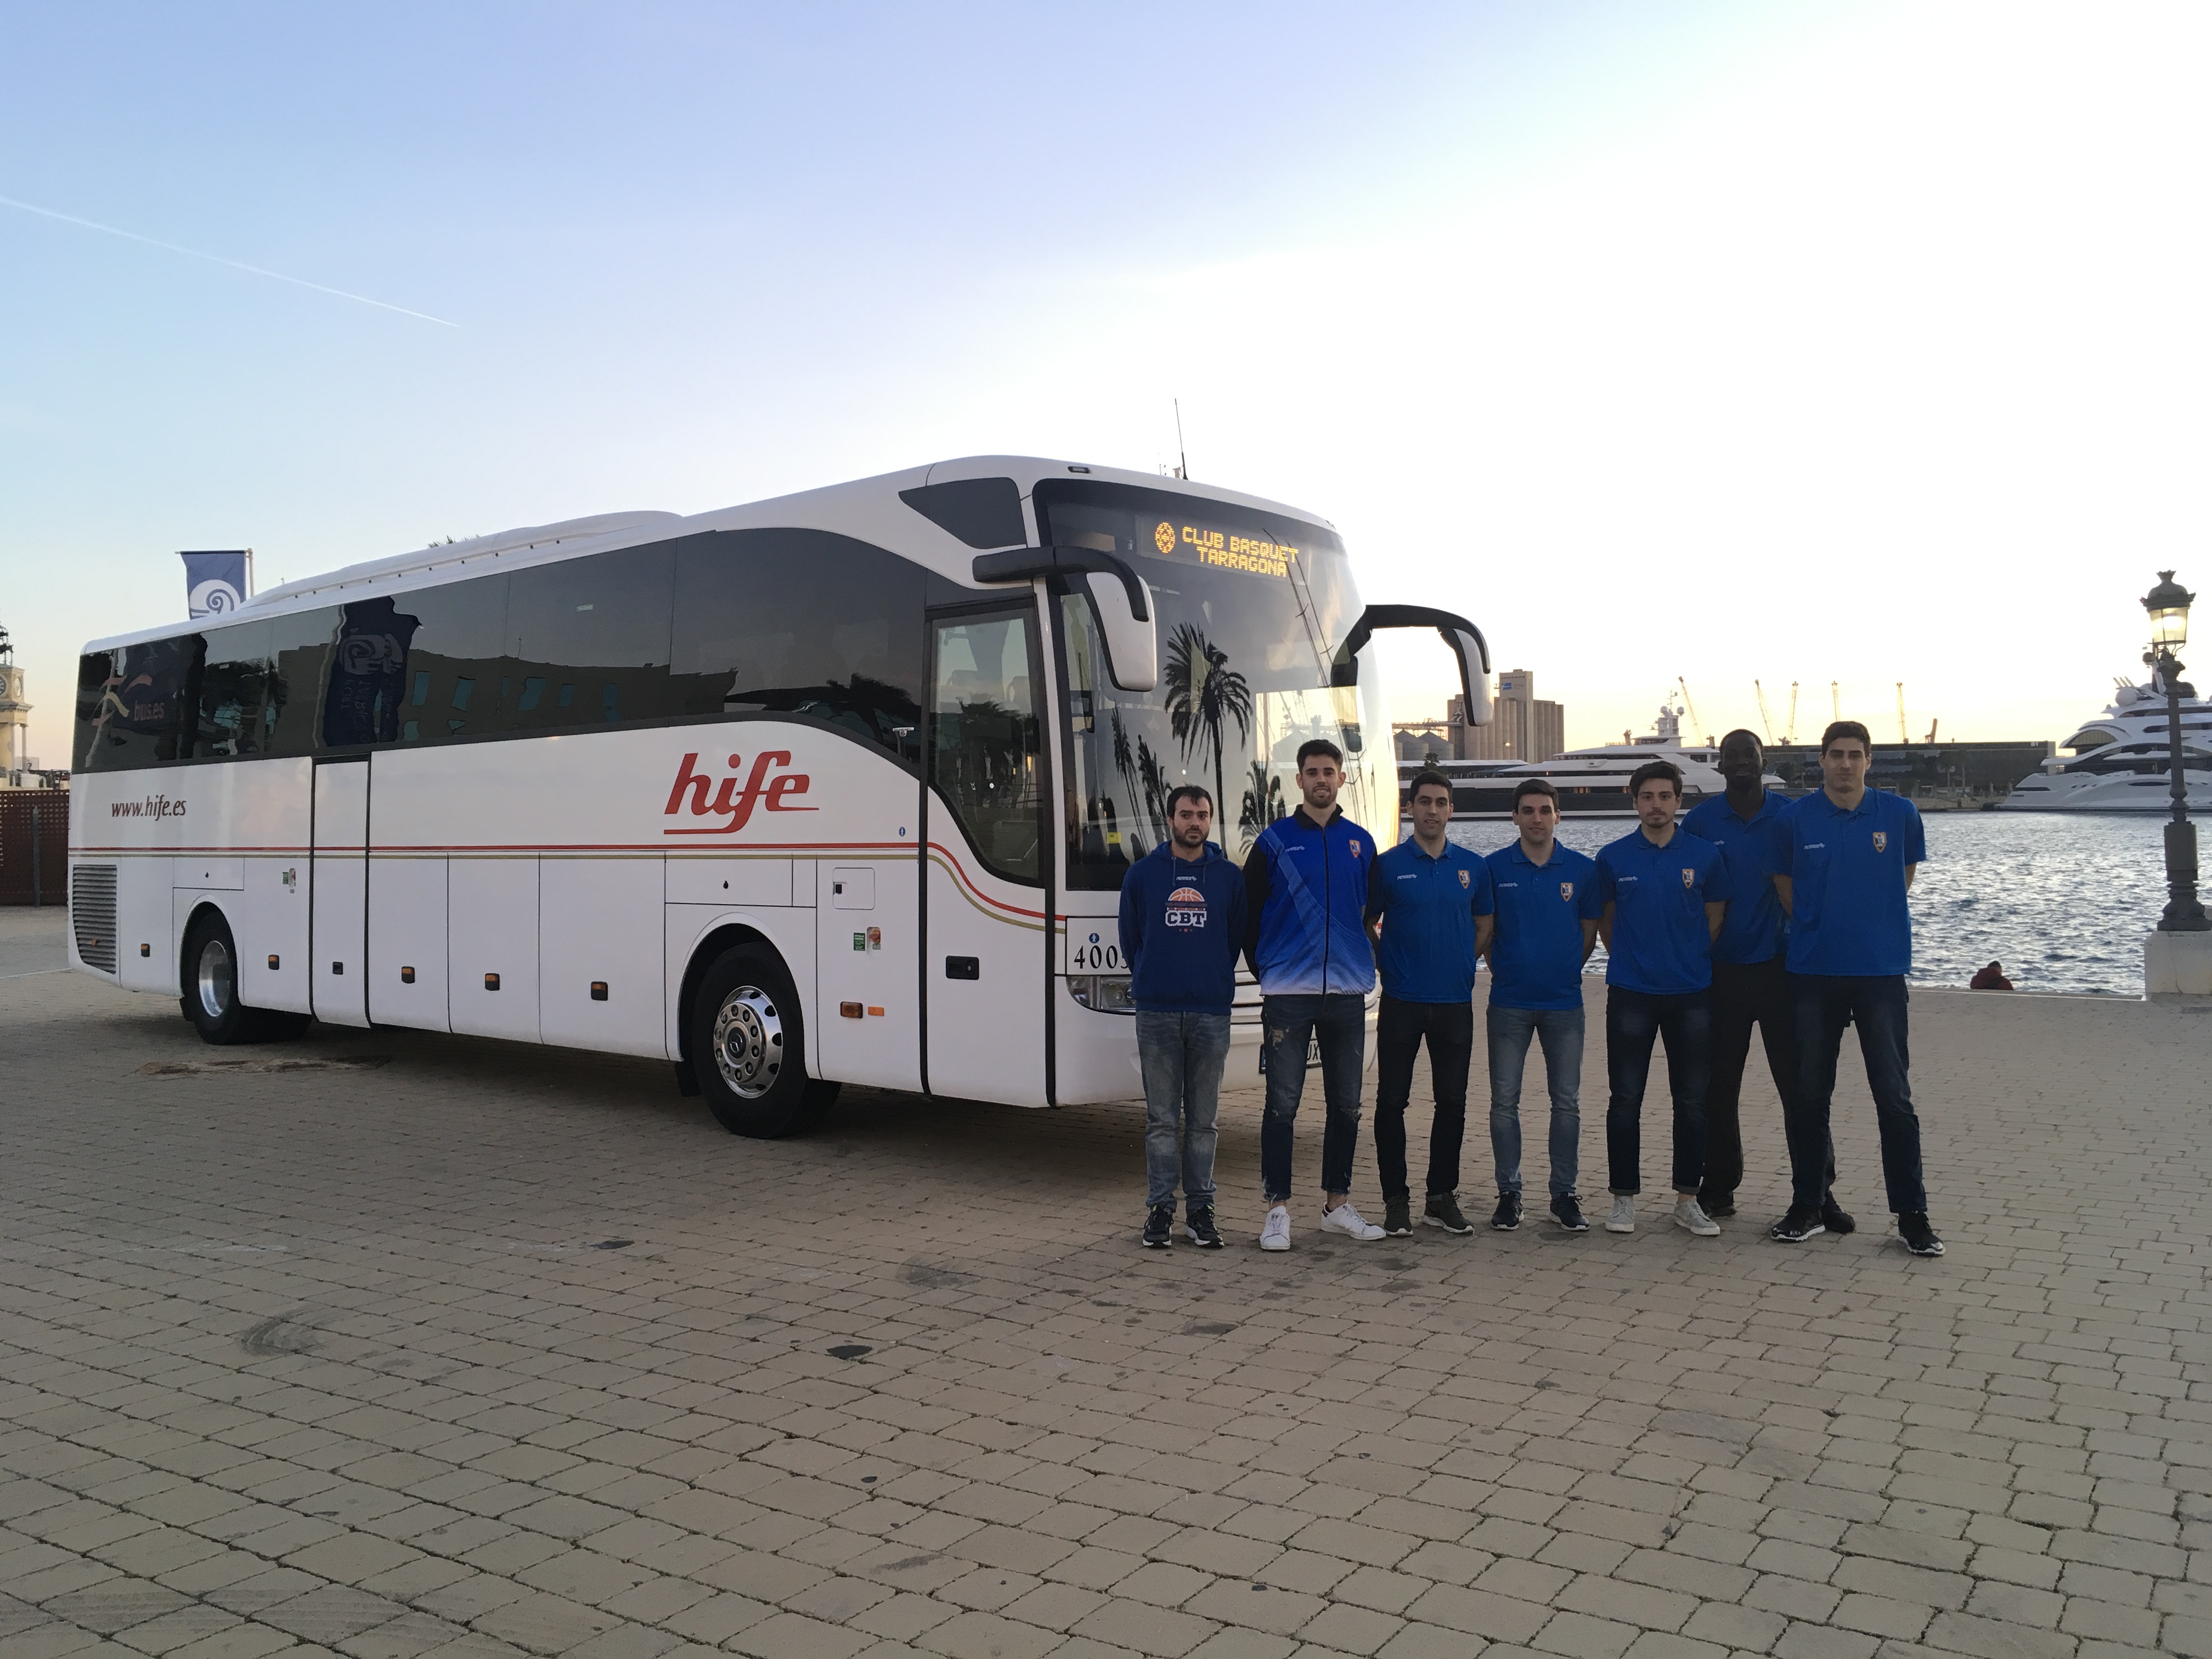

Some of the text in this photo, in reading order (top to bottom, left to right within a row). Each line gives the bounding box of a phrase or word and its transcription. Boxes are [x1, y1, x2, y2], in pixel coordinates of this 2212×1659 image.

[1182, 526, 1299, 563] CLUB BASQUET
[1197, 546, 1286, 578] TARRAGONA
[111, 794, 187, 822] www.hife.es
[663, 750, 820, 834] hife
[1165, 910, 1207, 928] CBT
